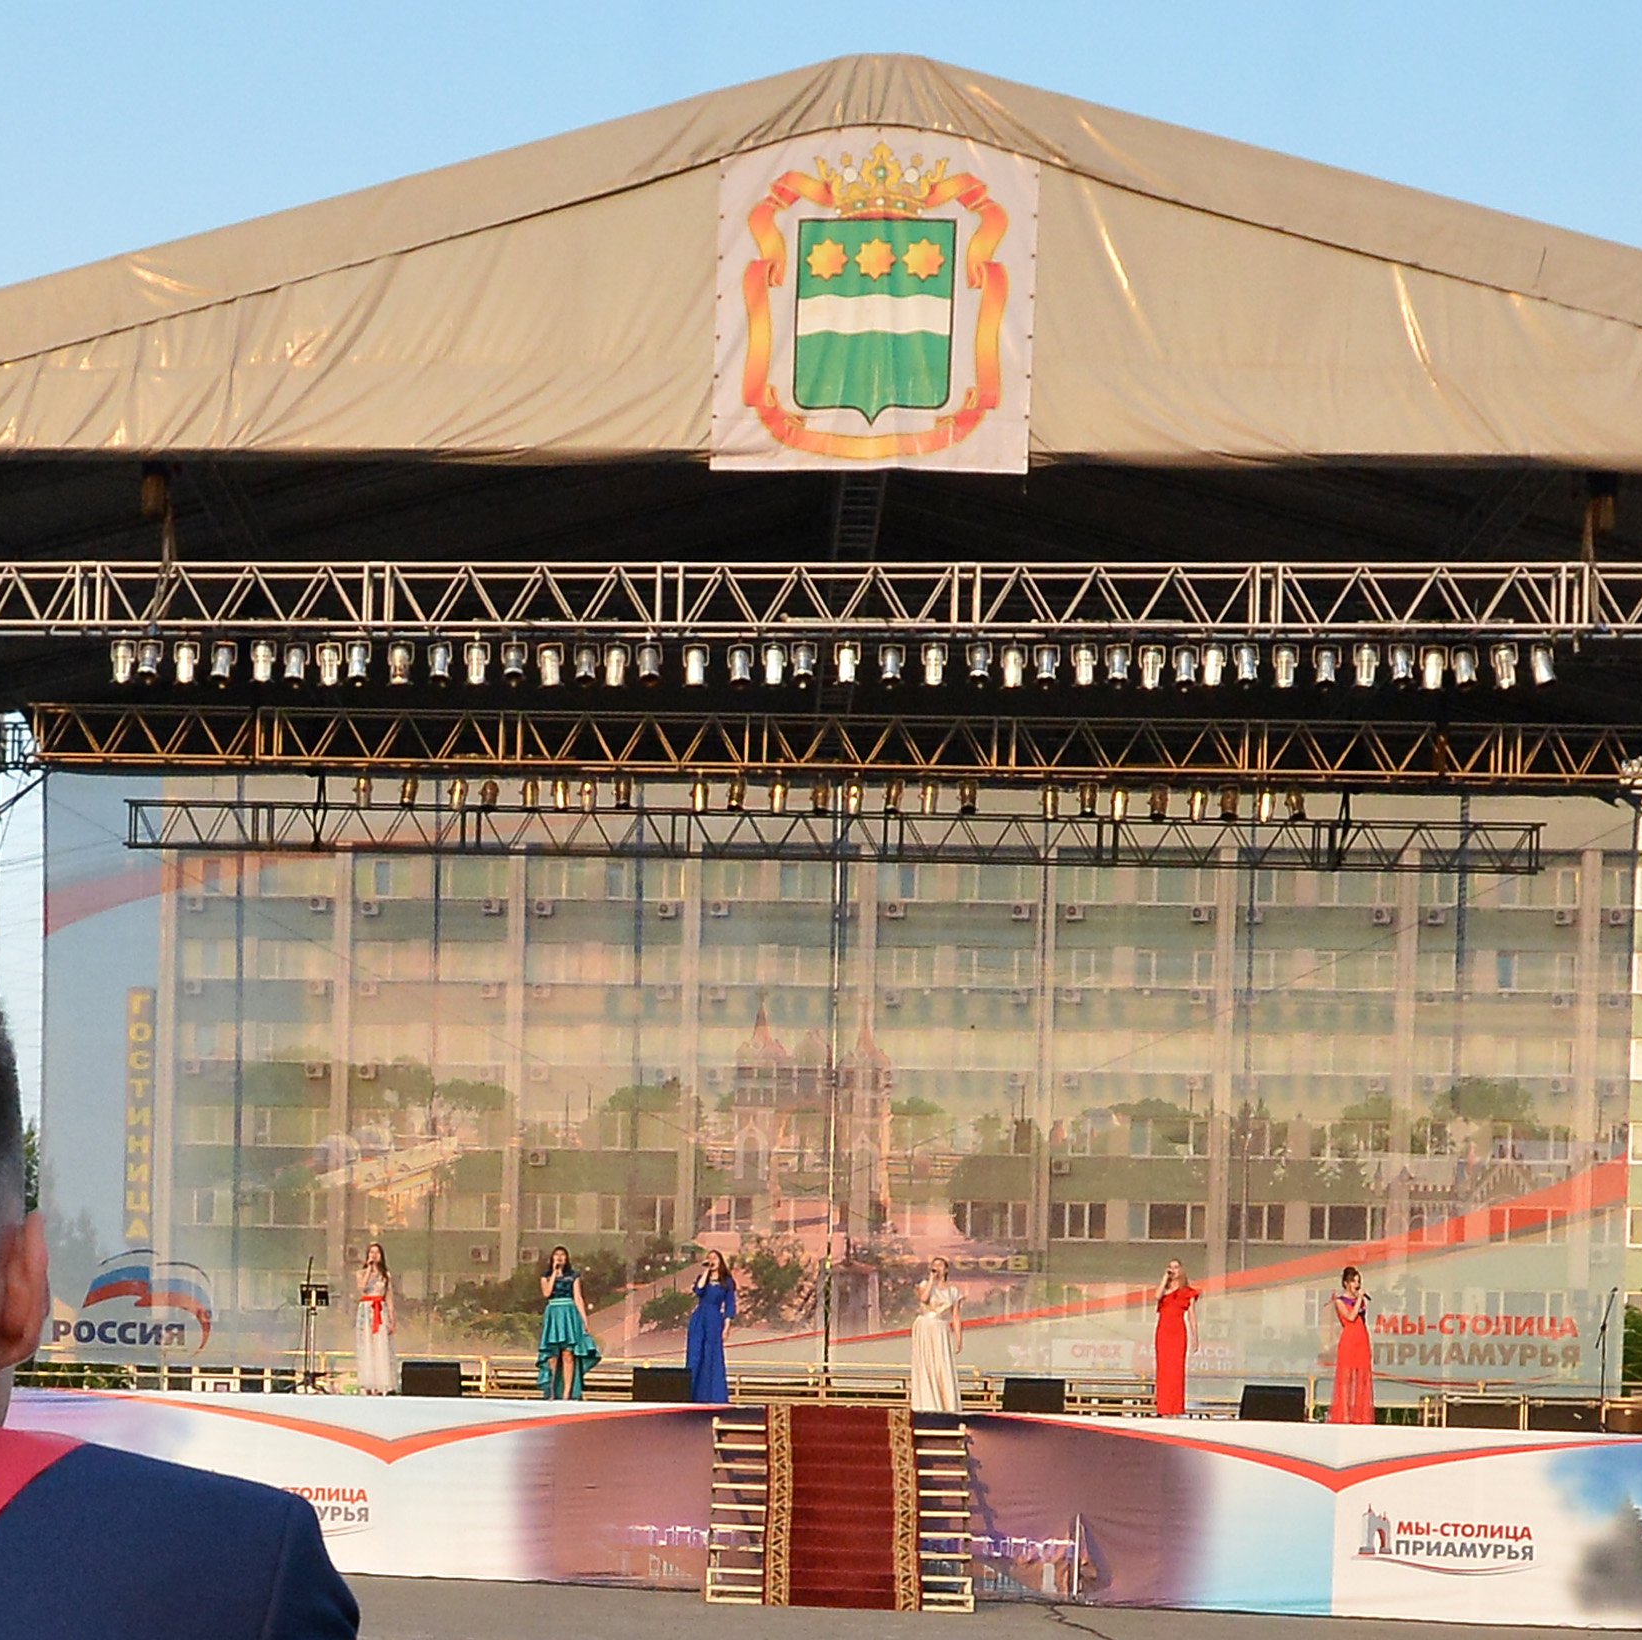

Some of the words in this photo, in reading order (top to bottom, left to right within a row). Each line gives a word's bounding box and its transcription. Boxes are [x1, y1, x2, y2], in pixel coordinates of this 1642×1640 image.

[52, 1319, 185, 1346] РОССИЯ
[1374, 1313, 1579, 1339] МЫ-СТОЛИЦА
[1373, 1341, 1581, 1369] ПРИАМУРЬЯ
[1396, 1521, 1533, 1542] МЫ-СТОЛИЦА
[1395, 1540, 1535, 1561] ПРИАМУРЬЯ
